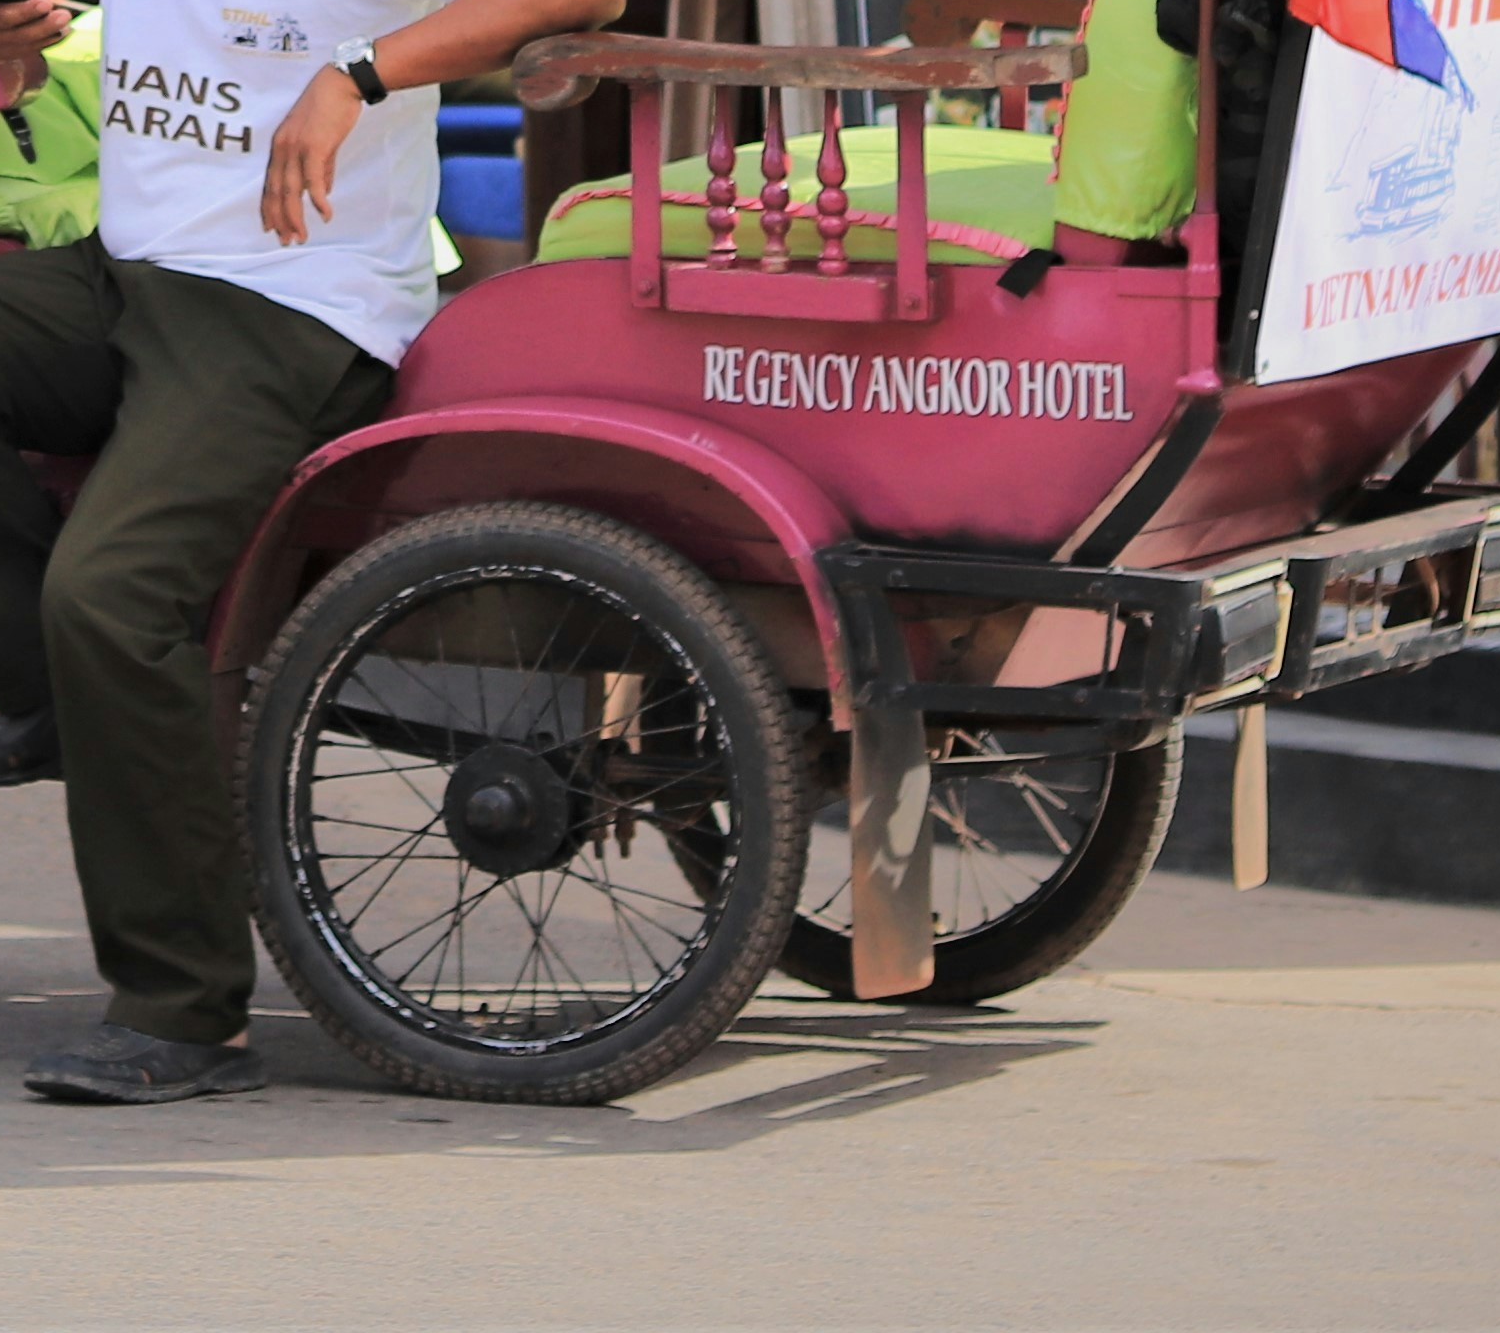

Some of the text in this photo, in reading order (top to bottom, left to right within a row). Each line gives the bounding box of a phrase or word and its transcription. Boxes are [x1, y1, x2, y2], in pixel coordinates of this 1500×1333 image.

[221, 7, 272, 27] STIHL
[105, 55, 243, 113] HANS
[105, 99, 253, 153] ARAH
[1303, 261, 1428, 331] VIETNAM
[702, 344, 1134, 423] REGENCY ANGKOR HOTEL
